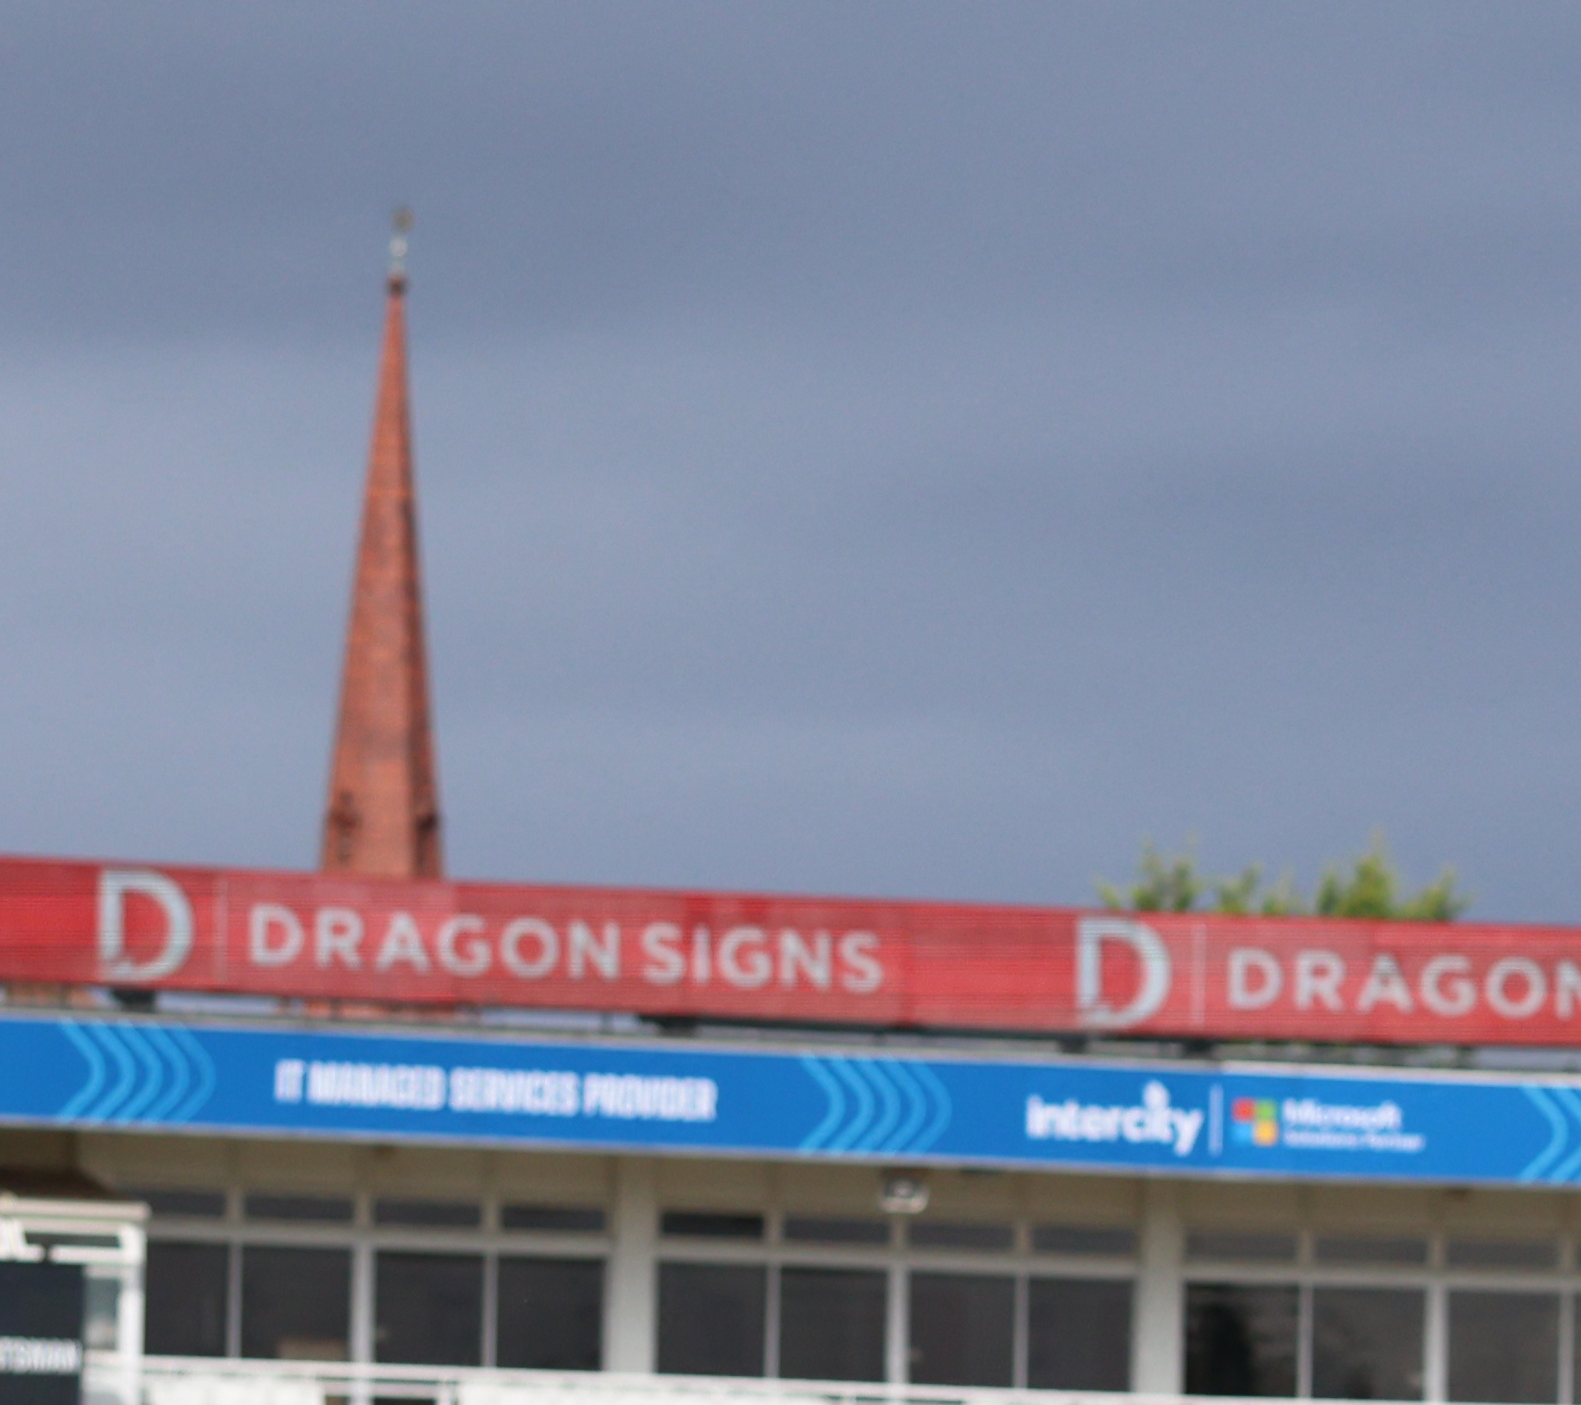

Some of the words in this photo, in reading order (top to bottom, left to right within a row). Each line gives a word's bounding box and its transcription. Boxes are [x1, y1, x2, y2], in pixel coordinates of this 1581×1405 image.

[98, 869, 193, 981] D
[249, 902, 619, 982] DRAGON
[642, 922, 883, 994] SIGNS
[1075, 917, 1169, 1028] D
[307, 1061, 447, 1111] MANAGED
[449, 1066, 579, 1117] SERVICES
[581, 1072, 718, 1122] PROVIDER
